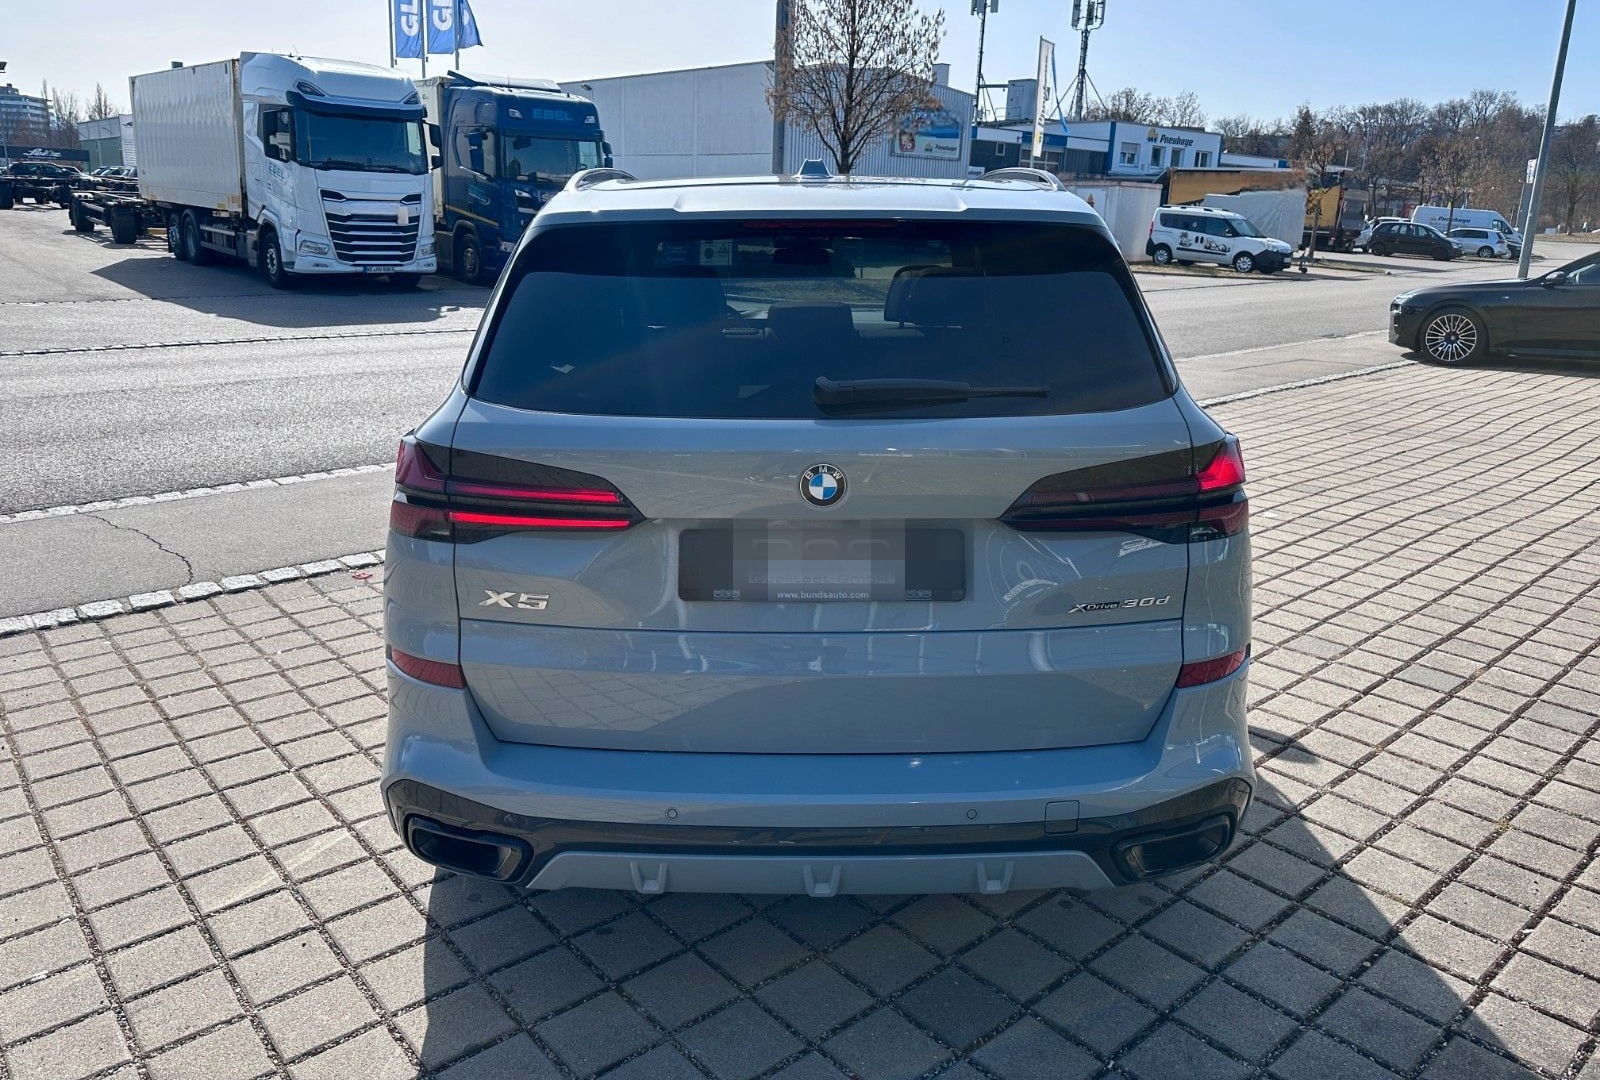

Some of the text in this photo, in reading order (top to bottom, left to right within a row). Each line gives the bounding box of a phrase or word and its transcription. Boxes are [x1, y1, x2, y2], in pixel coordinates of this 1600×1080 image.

[533, 108, 573, 121] EBEL
[268, 161, 284, 179] EBEL
[804, 465, 842, 480] BMW
[478, 589, 550, 610] X5
[776, 590, 869, 599] www.bundsauto.com
